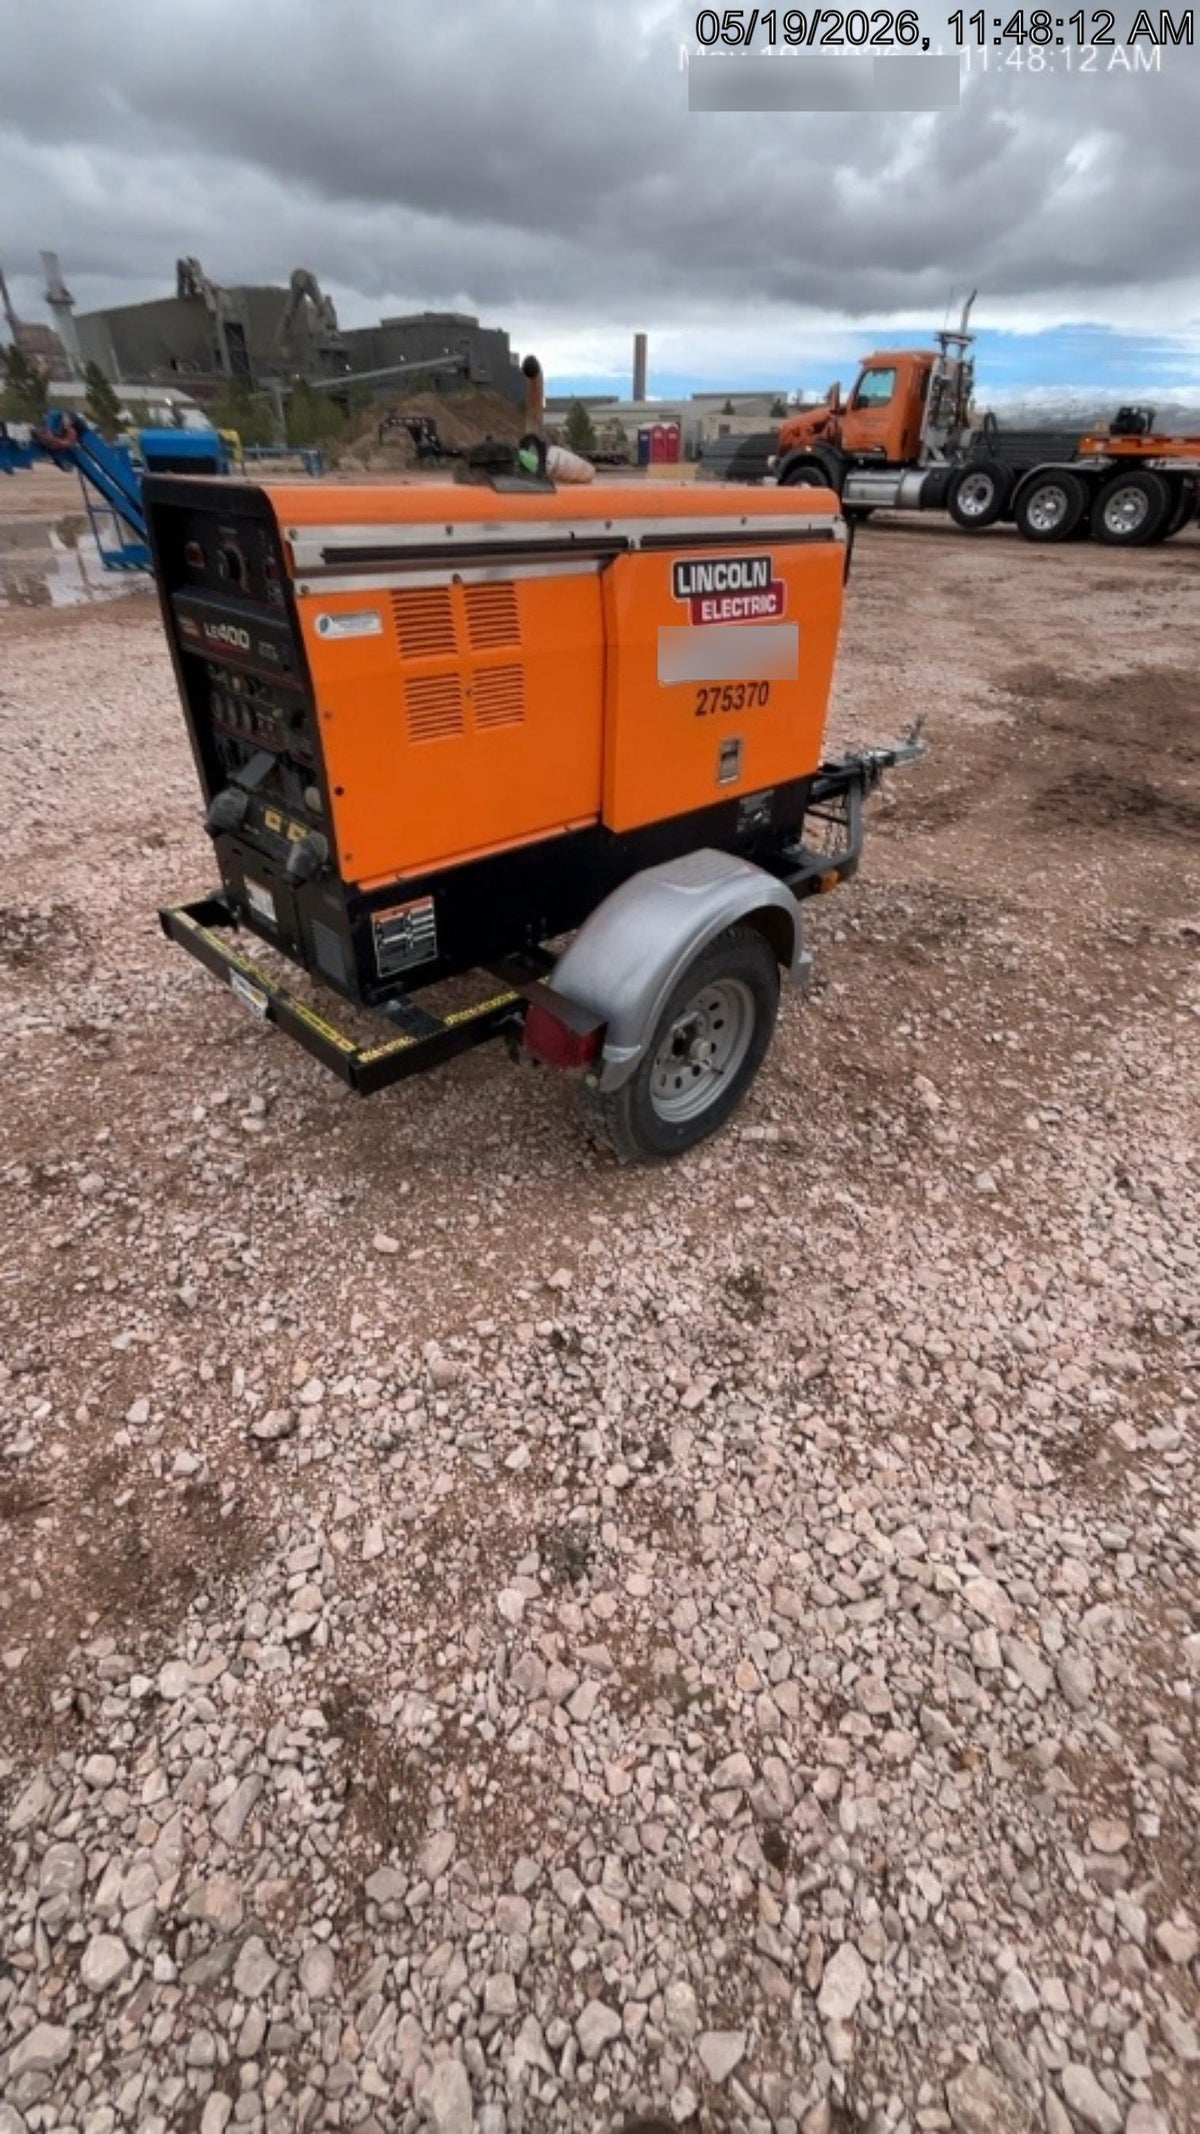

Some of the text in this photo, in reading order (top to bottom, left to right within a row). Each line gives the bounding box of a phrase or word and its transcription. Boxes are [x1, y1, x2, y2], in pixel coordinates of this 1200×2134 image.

[677, 561, 767, 594] LINCOLN
[700, 594, 777, 621] ELECTRIC
[694, 680, 770, 717] 275370
